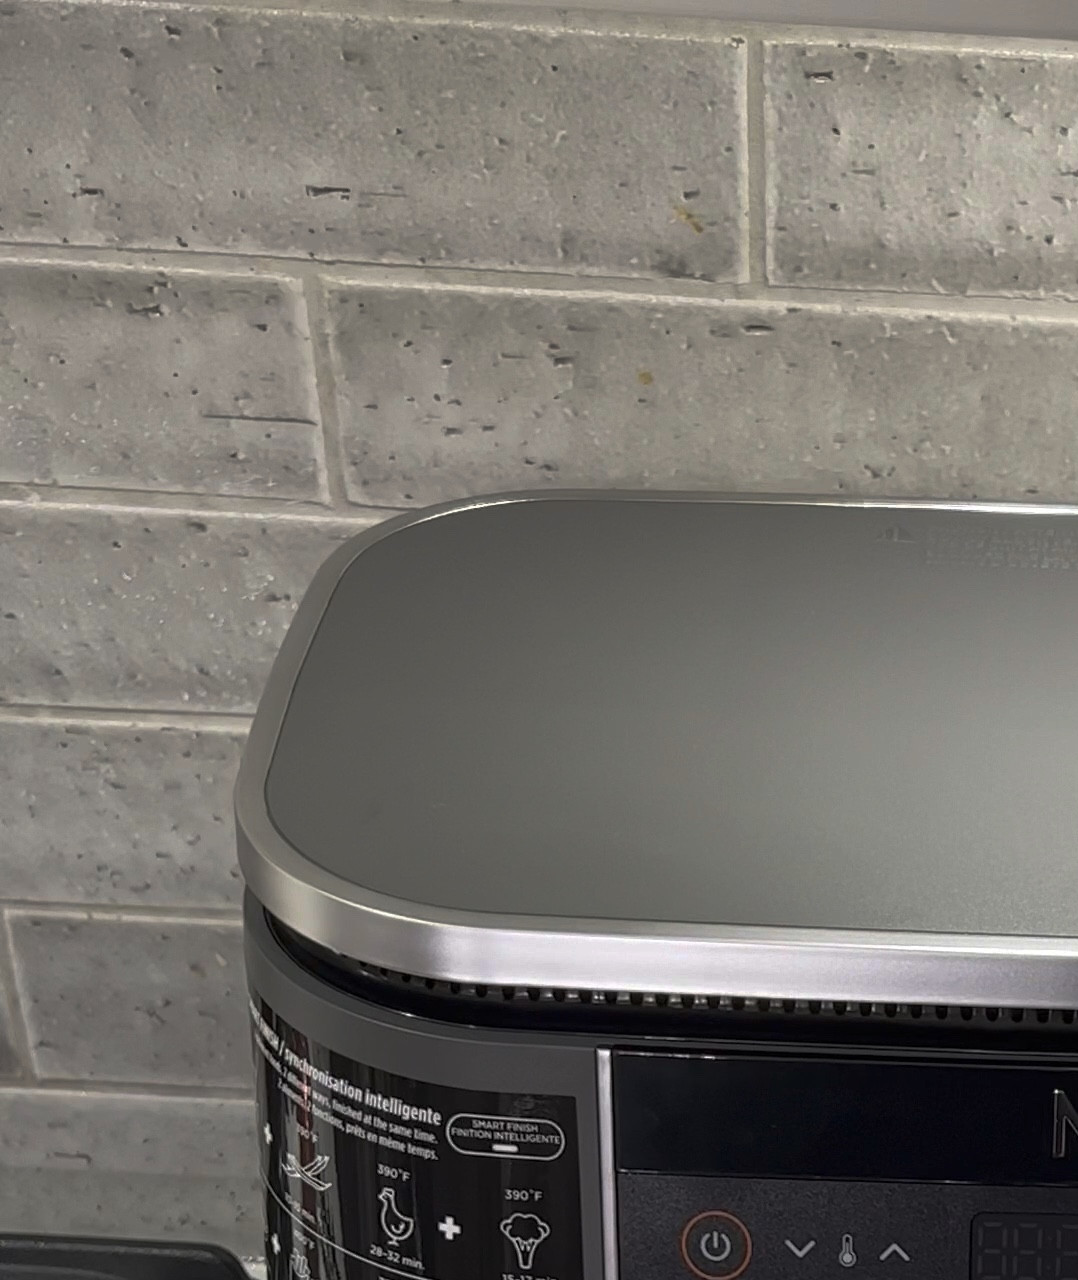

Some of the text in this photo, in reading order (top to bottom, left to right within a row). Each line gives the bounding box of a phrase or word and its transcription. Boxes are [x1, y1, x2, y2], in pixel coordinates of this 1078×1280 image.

[285, 1048, 363, 1102] synchronisation
[364, 1089, 442, 1126] intelligente
[373, 1116, 388, 1131] the
[388, 1123, 413, 1138] same
[413, 1128, 438, 1144] time.
[451, 1127, 561, 1145] FINITION INTELLIGENTE
[472, 1119, 539, 1133] SMART FINISH
[367, 1131, 378, 1144] en
[406, 1142, 439, 1161] temps.
[369, 1244, 425, 1271] 28-32 min.
